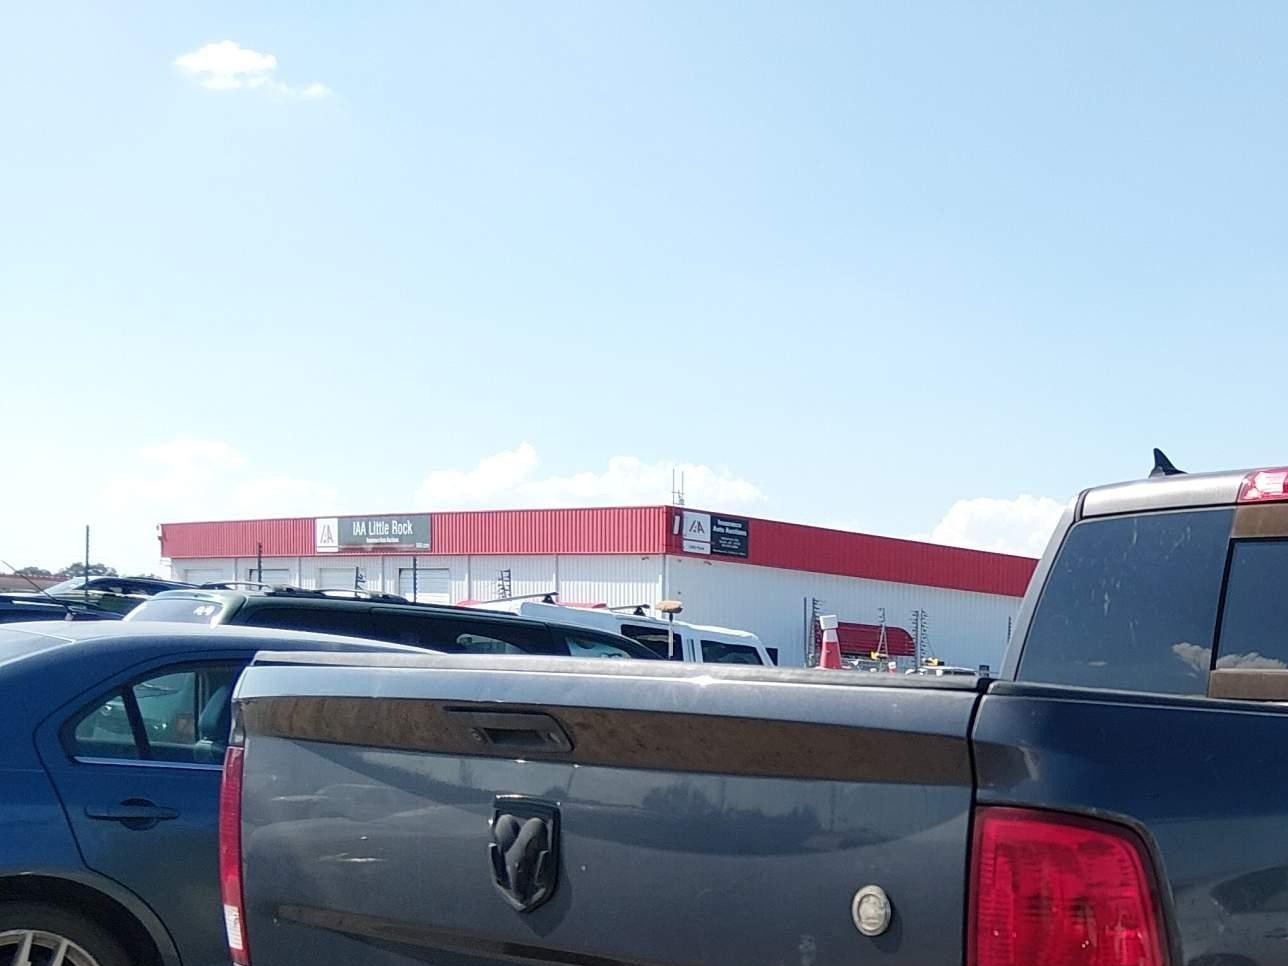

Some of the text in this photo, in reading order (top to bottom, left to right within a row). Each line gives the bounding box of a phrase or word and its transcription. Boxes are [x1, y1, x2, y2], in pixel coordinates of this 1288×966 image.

[352, 520, 413, 536] IAA Little Rock
